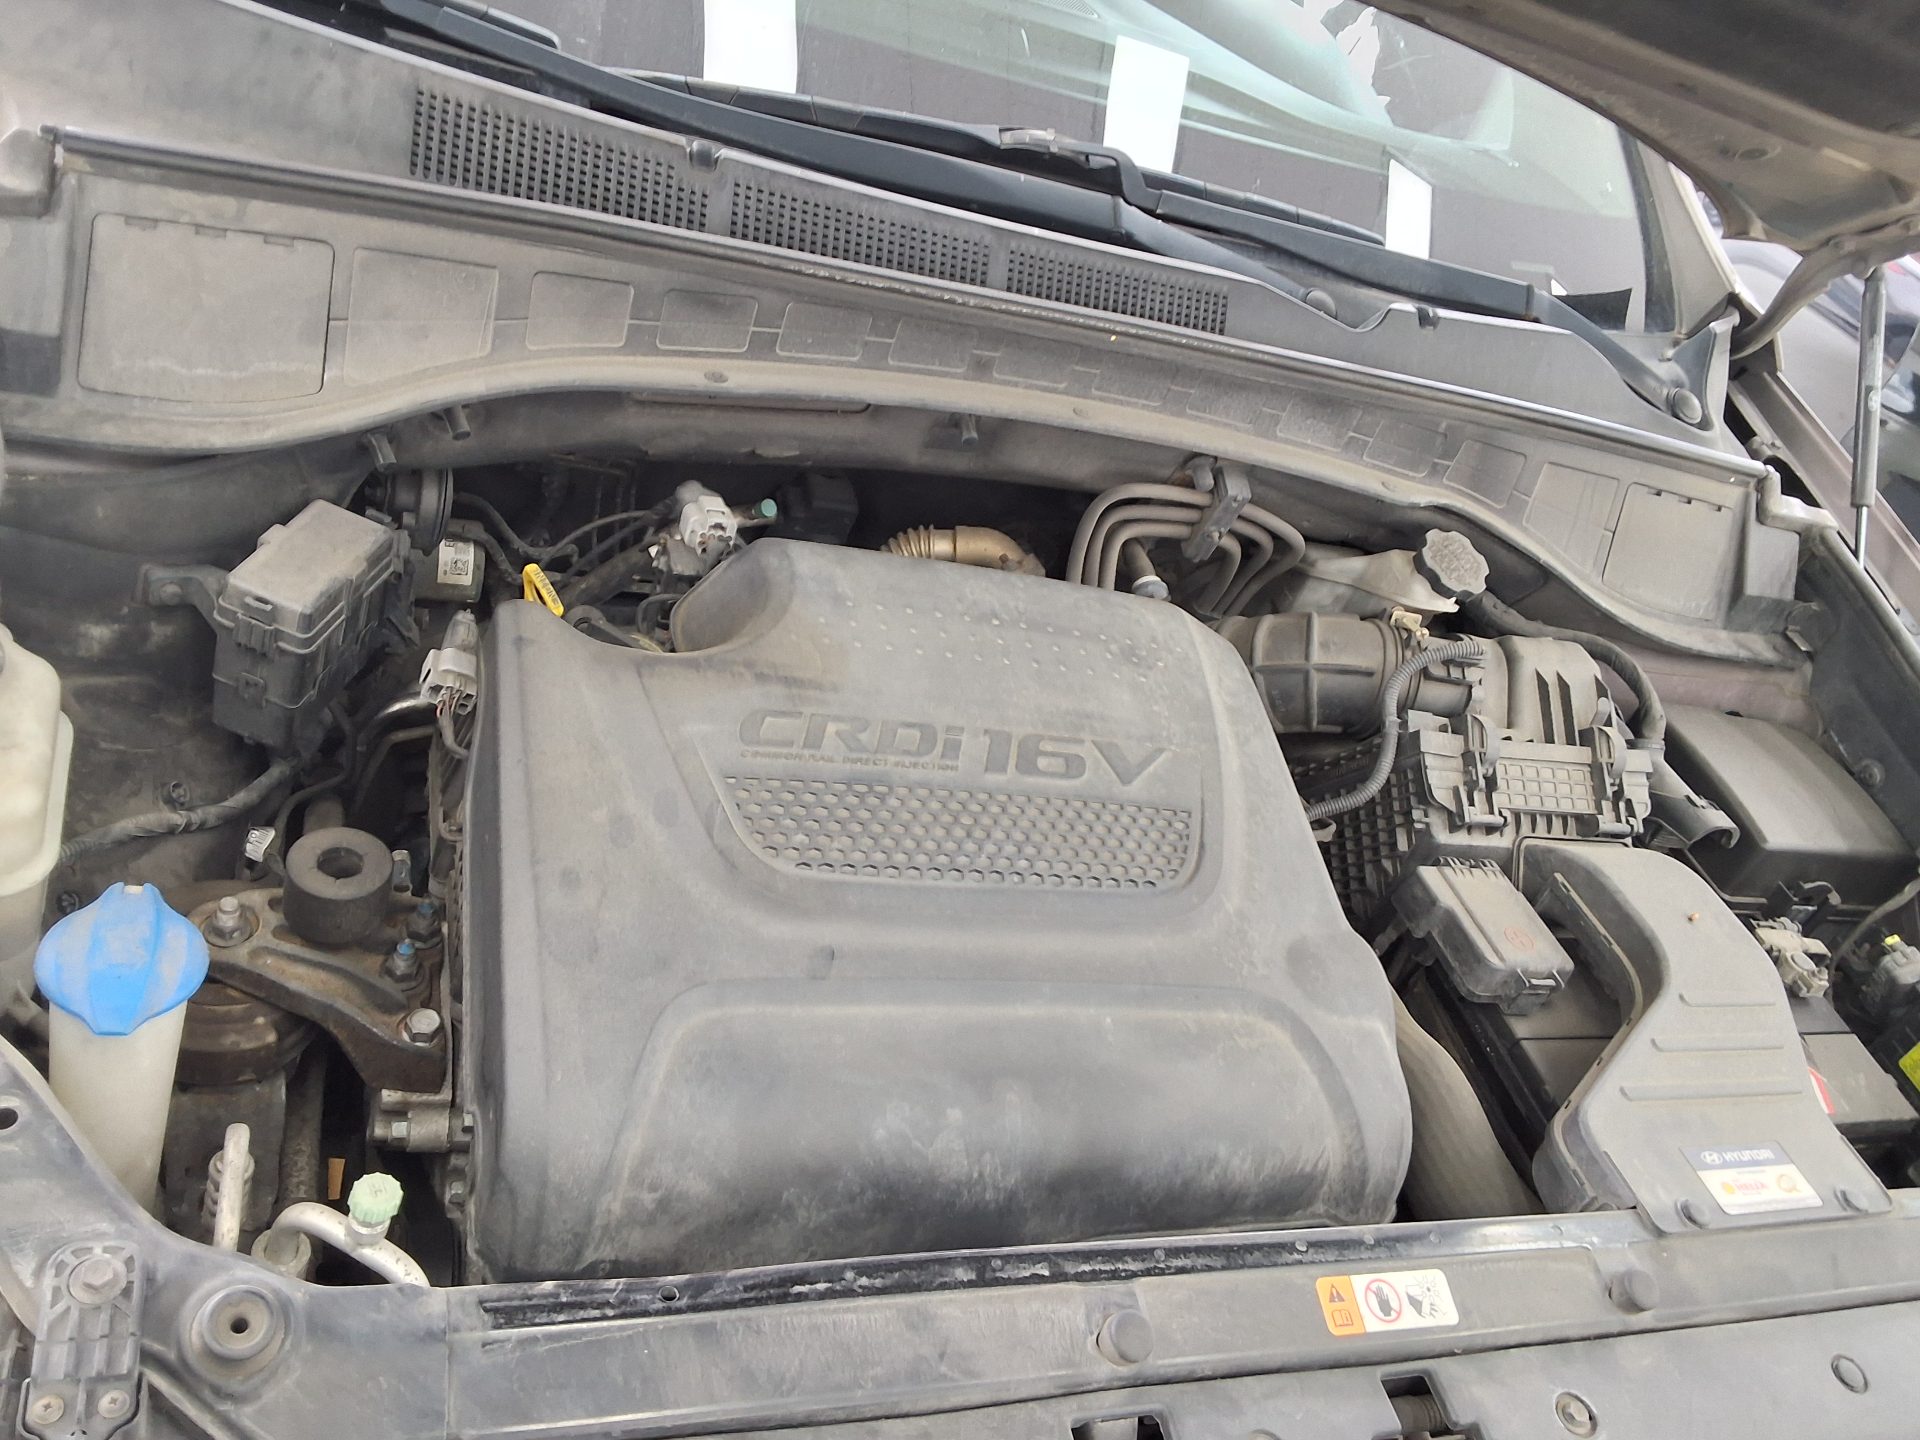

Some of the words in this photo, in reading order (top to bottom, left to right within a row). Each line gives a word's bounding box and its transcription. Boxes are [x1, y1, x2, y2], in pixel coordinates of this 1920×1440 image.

[739, 710, 965, 761] CRDi
[984, 728, 1167, 787] 16V
[1722, 1148, 1776, 1163] HYUNDAI
